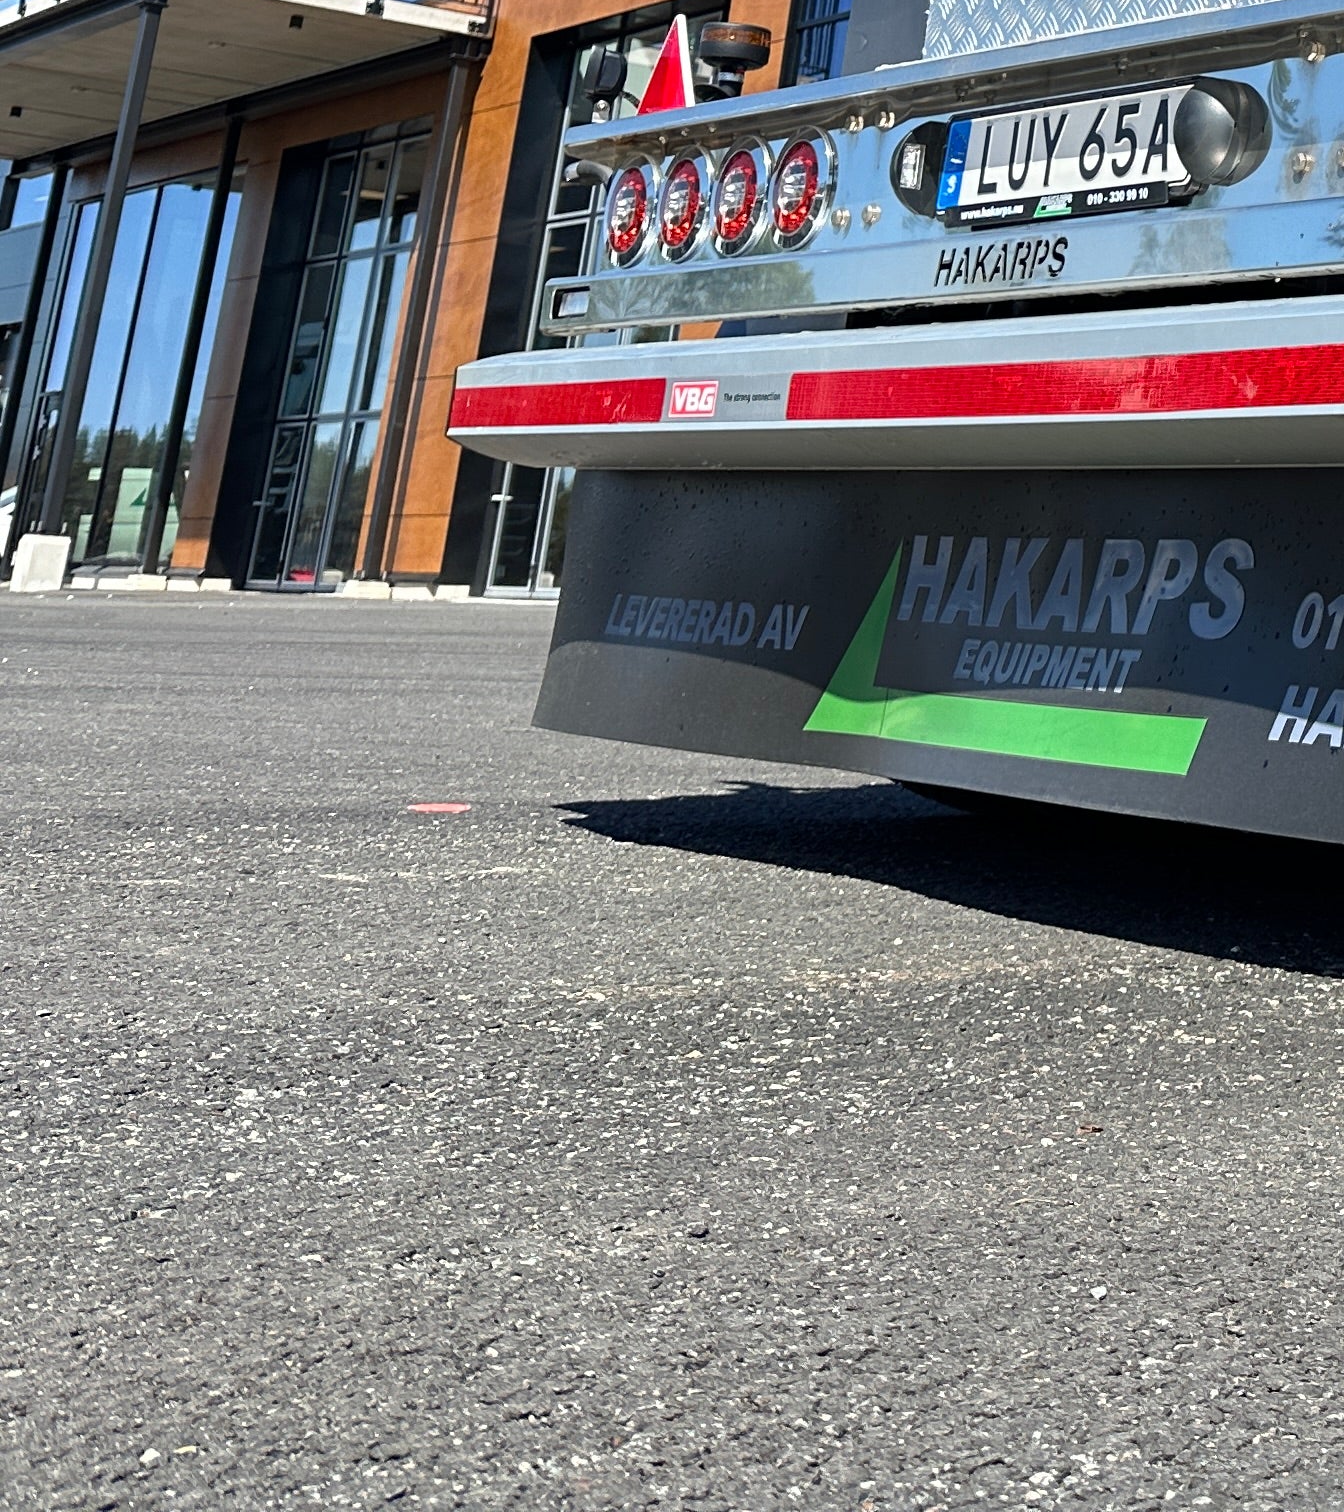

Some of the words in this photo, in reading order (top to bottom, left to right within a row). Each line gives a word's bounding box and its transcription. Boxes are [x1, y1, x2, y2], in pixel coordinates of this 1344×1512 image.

[977, 110, 1068, 195] LUY
[1078, 93, 1169, 182] 65A
[960, 204, 1024, 220] www.hakarps.nu
[1086, 192, 1103, 206] 010
[1109, 190, 1125, 203] 330
[1138, 187, 1149, 199] 10
[934, 236, 1068, 287] HAKARPS
[674, 387, 716, 412] VBG
[898, 535, 1255, 640] HAKARPS
[604, 594, 757, 646] LEVERERAD
[757, 603, 809, 650] AV
[953, 639, 1142, 694] EQUIPMENT
